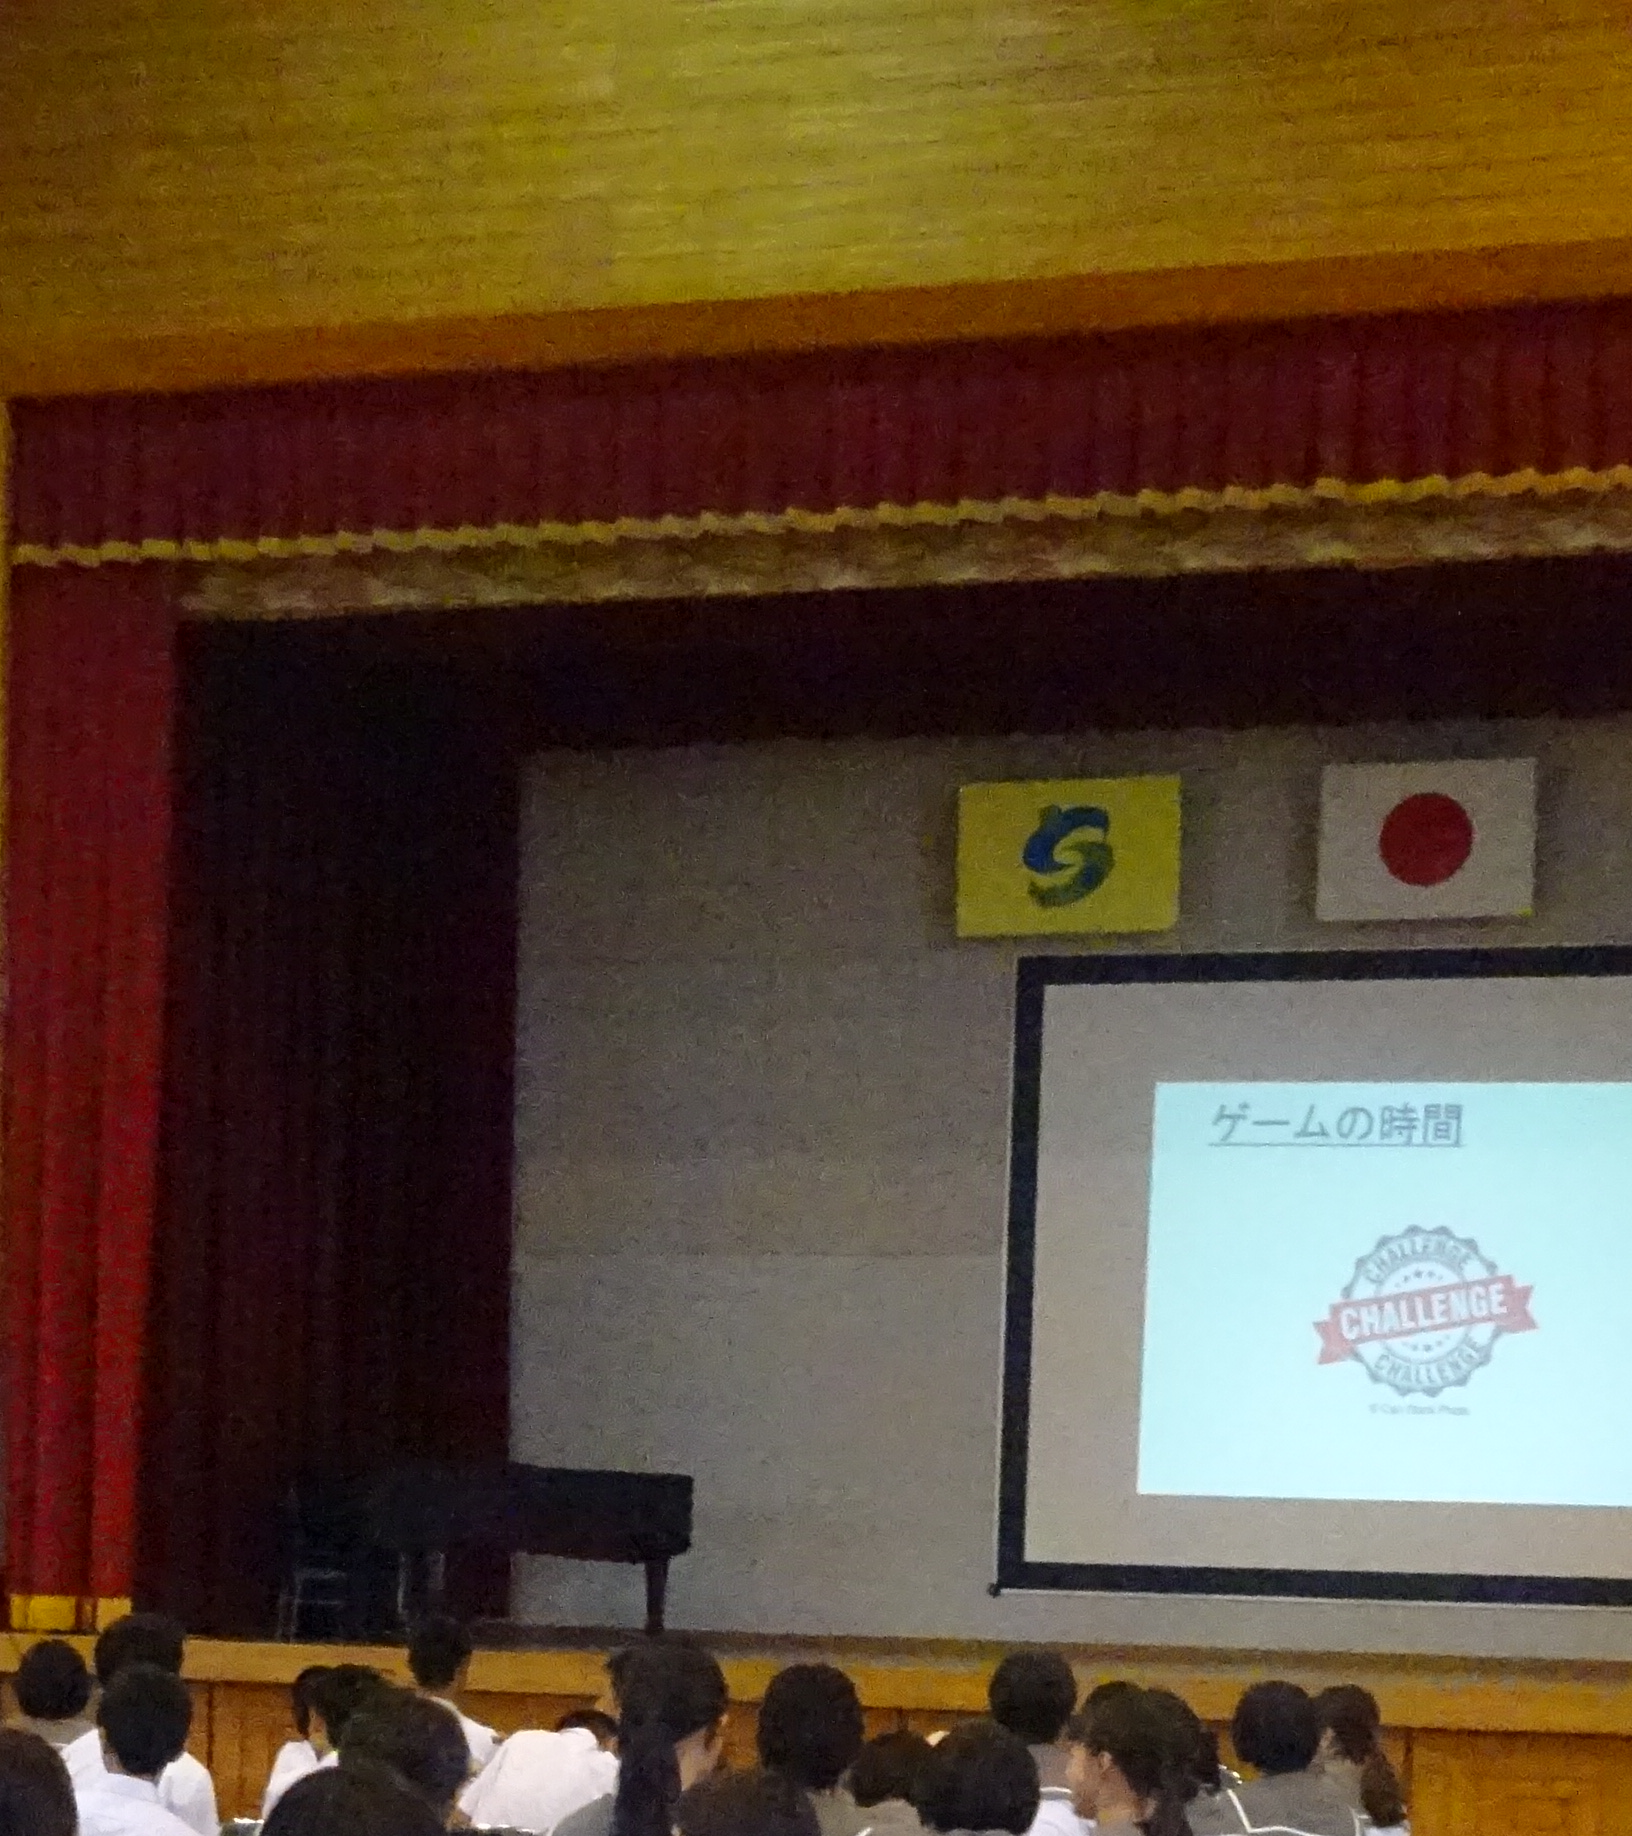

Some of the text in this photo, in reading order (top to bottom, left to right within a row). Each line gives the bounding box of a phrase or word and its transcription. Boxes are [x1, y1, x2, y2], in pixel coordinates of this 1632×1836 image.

[1211, 1101, 1464, 1147] ゲームの時間
[1339, 1282, 1508, 1341] CHALLENGE
